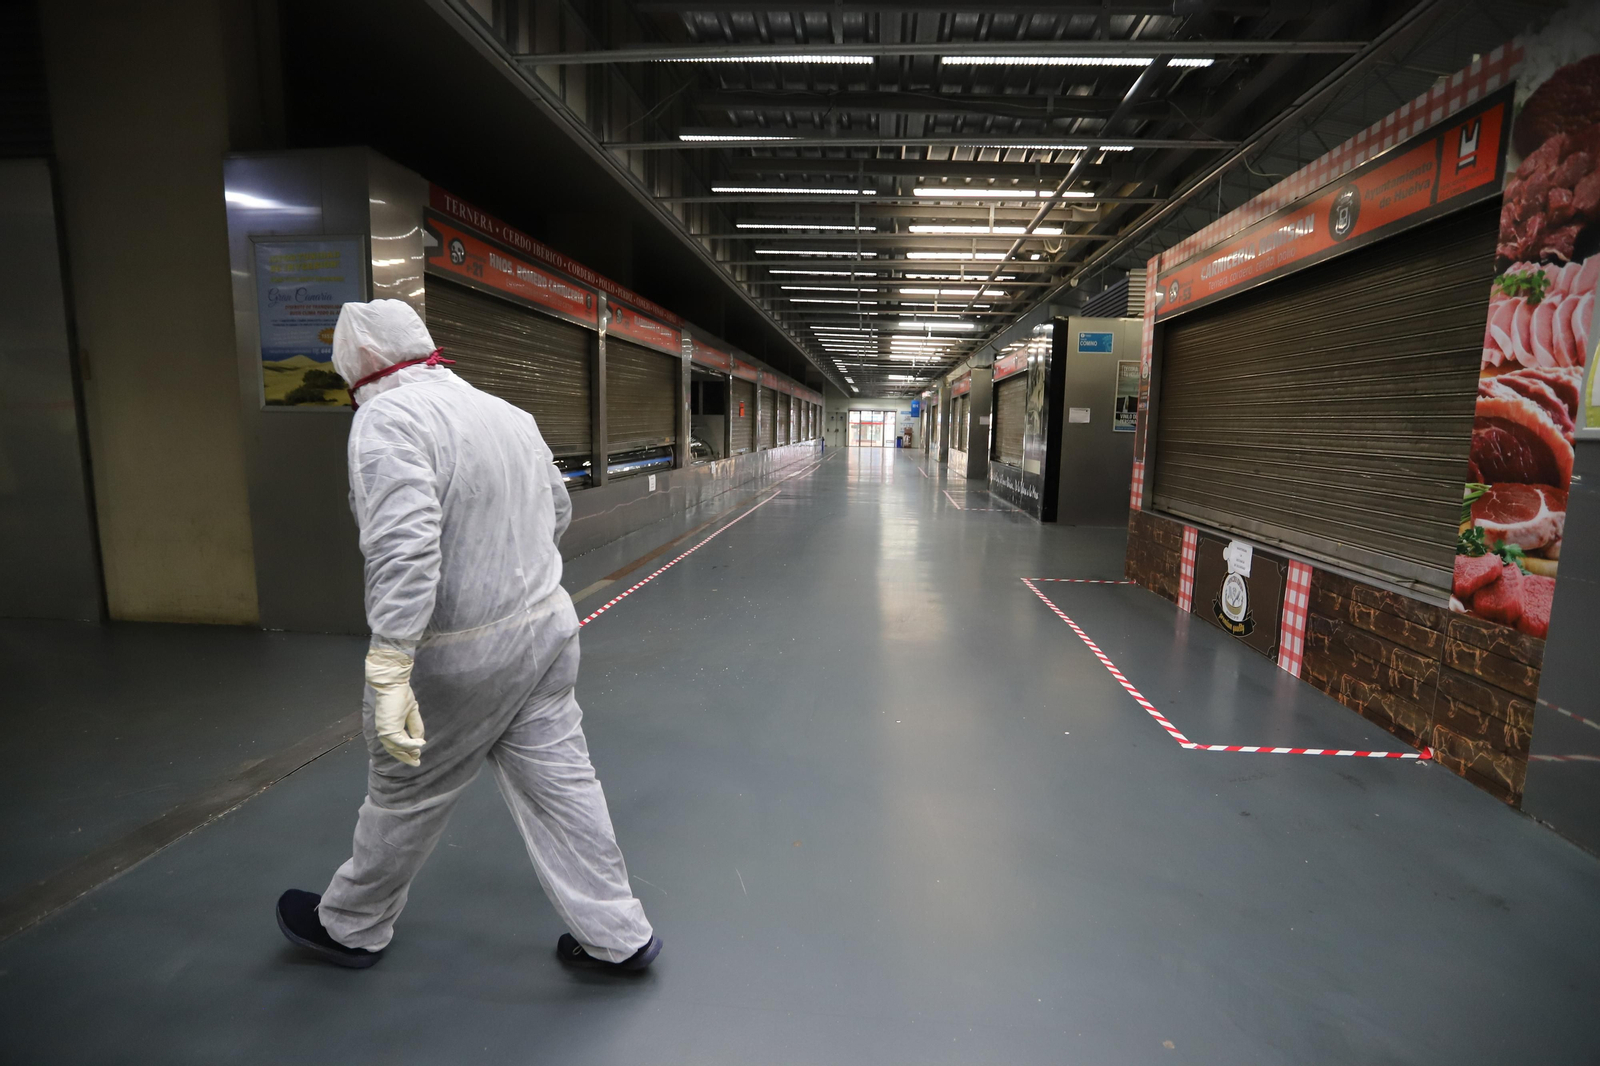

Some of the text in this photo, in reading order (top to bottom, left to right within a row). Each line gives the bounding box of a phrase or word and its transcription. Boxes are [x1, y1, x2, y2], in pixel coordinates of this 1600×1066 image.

[1364, 160, 1433, 202] Ayuntamiento
[1379, 194, 1390, 210] de
[1394, 178, 1431, 204] Huelva
[444, 195, 493, 233] TERNERA
[503, 227, 531, 252] CERDO
[533, 244, 563, 268] IBÉRICO
[567, 261, 596, 283] CORDERO
[599, 277, 615, 294] POLLO
[617, 287, 634, 302] PERDIZ
[1200, 213, 1315, 282] CARNICERÍA REMISAN
[1277, 246, 1297, 265] pollo
[489, 252, 514, 276] HNOS.
[516, 264, 548, 289] ROMERO
[267, 287, 333, 308] Gran Canaria
